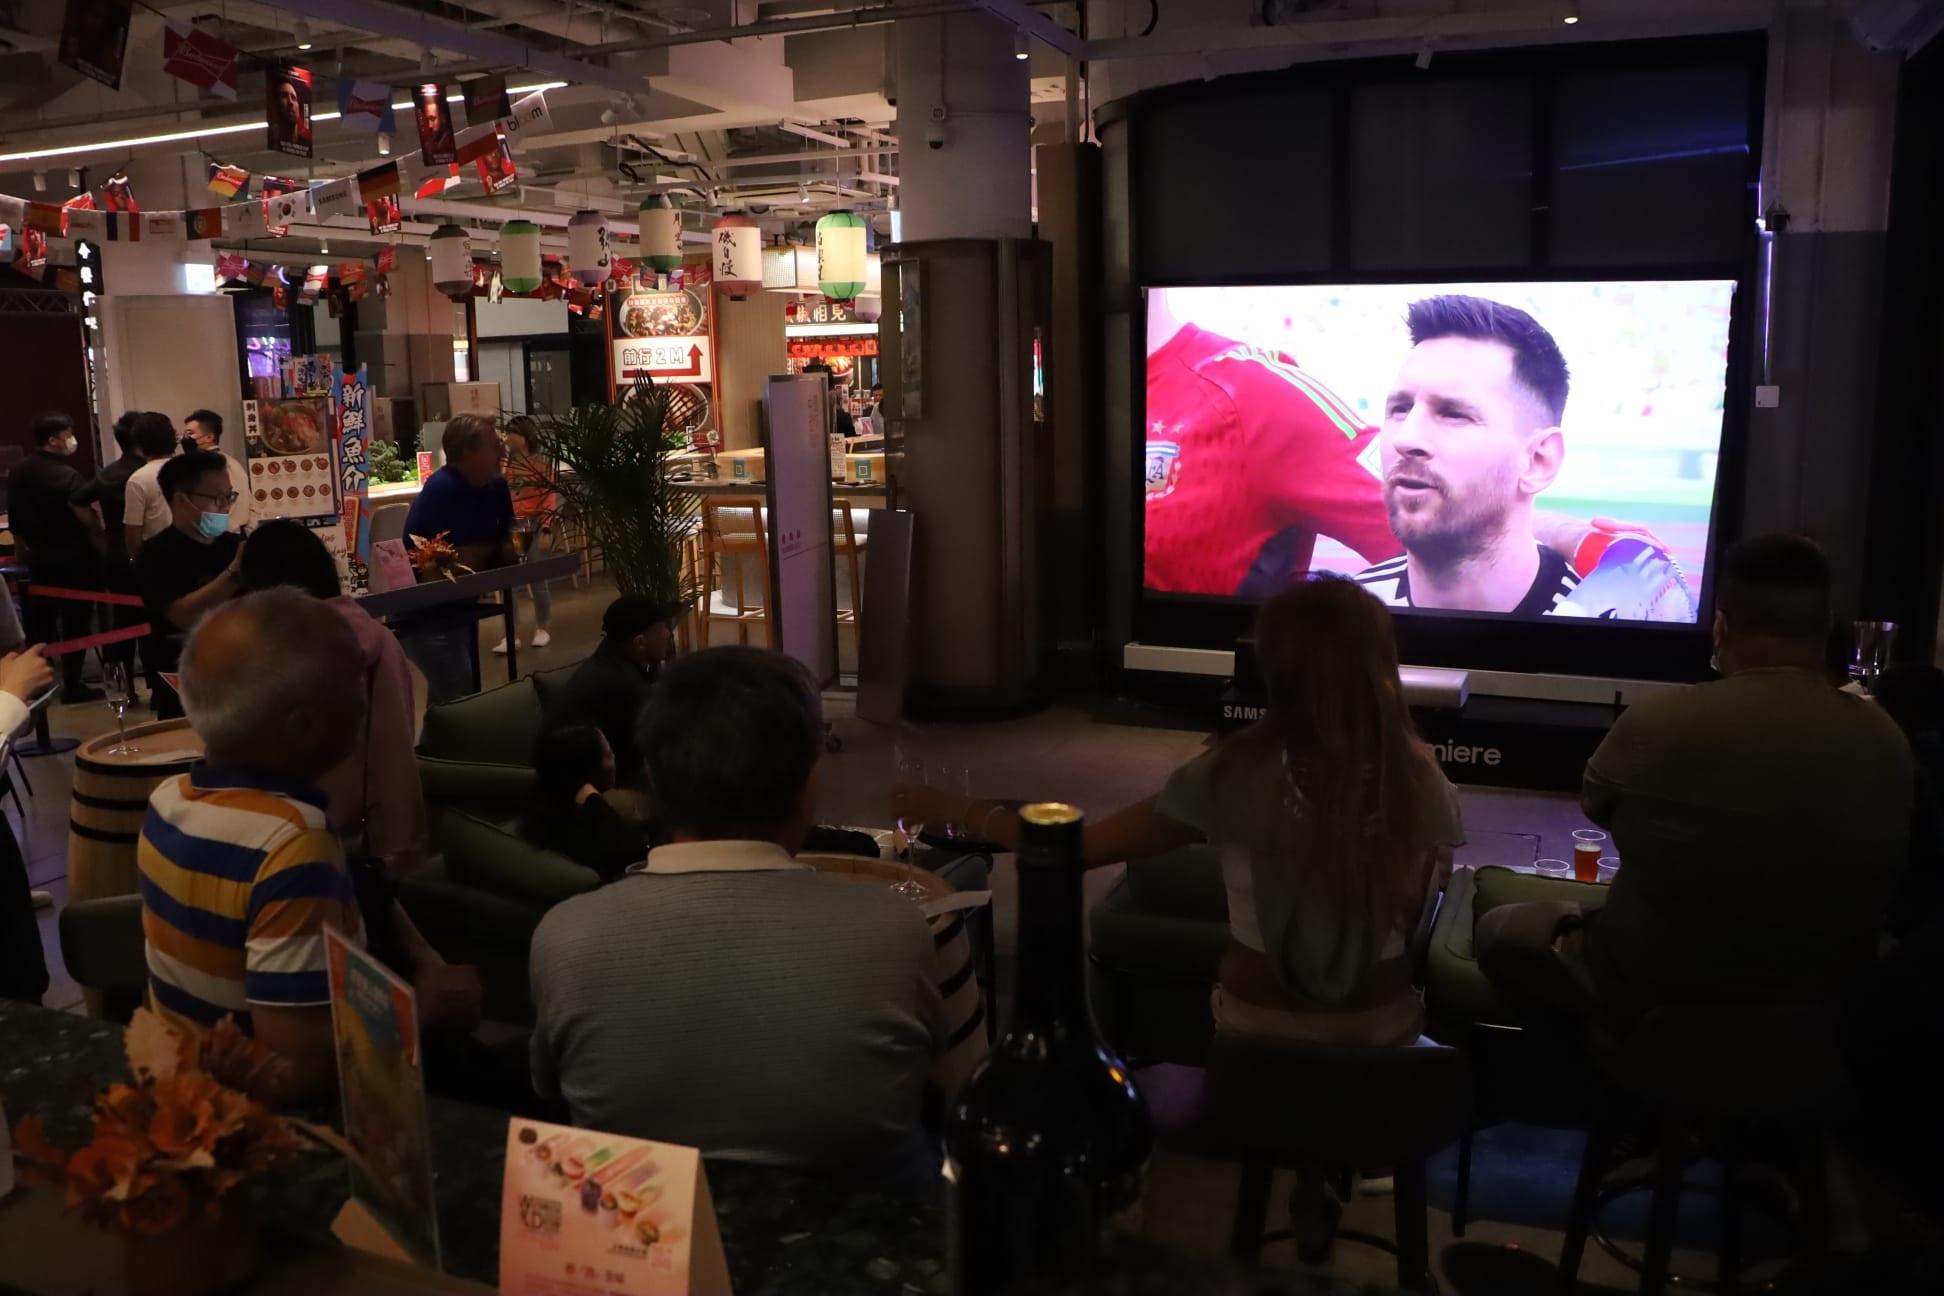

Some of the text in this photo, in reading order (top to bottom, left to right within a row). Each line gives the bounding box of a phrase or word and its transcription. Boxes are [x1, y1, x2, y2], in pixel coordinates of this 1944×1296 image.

[623, 346, 684, 365] 前行 2 M
[341, 383, 366, 491] 新鮮魚介
